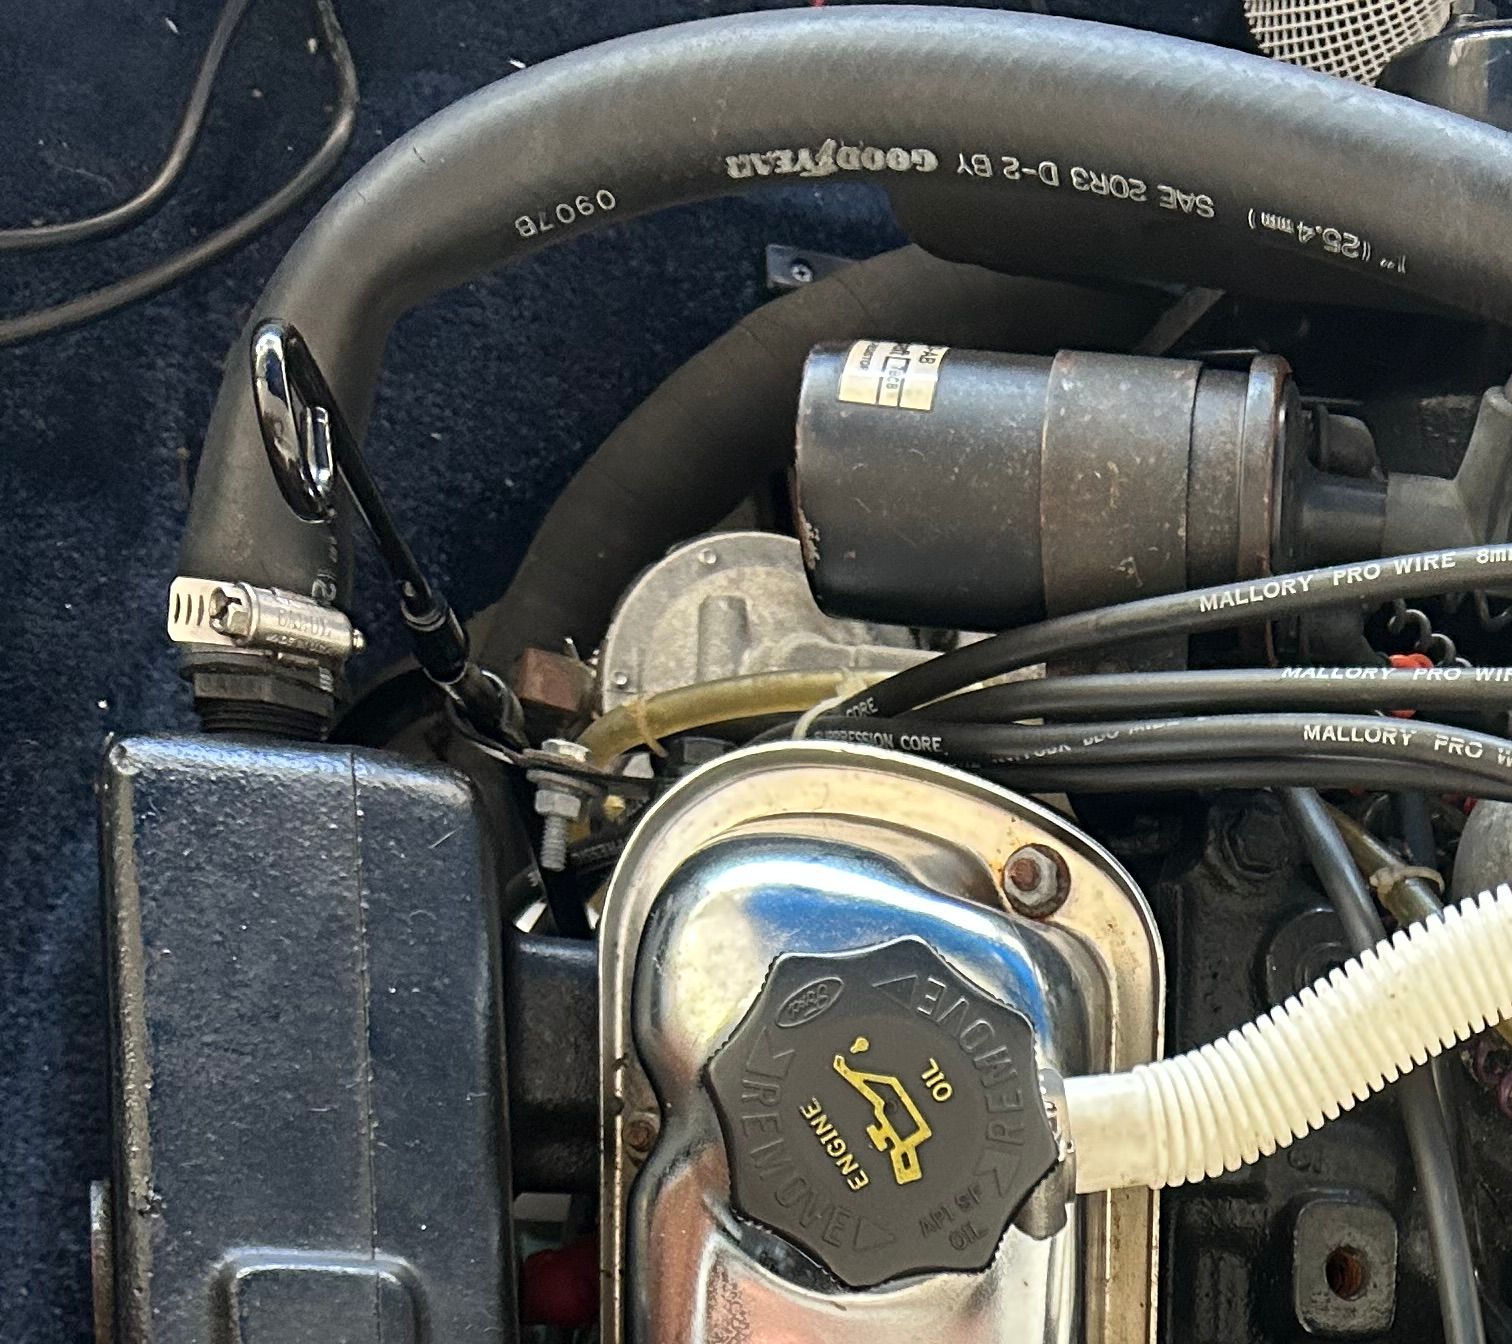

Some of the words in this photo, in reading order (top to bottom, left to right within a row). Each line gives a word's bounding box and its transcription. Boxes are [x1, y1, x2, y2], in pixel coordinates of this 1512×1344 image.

[723, 139, 938, 181] GOODYEAR
[956, 152, 994, 178] BY
[1001, 156, 1059, 188] D-2
[1070, 165, 1148, 203] 20R3
[1158, 184, 1214, 219] SAE
[1199, 570, 1315, 613] MALLORY
[1331, 562, 1381, 586] PRO
[1394, 551, 1456, 576] WIRE
[1281, 667, 1395, 681] MALLORY
[1412, 667, 1461, 681] PRO
[1303, 725, 1414, 748] MALLORY
[1433, 734, 1484, 759] PRO
[916, 976, 1024, 1146] REMOVE
[921, 1058, 953, 1102] OIL
[740, 1078, 850, 1247] REMOVE
[800, 1096, 870, 1192] ENGINE
[949, 1223, 989, 1251] OIL
